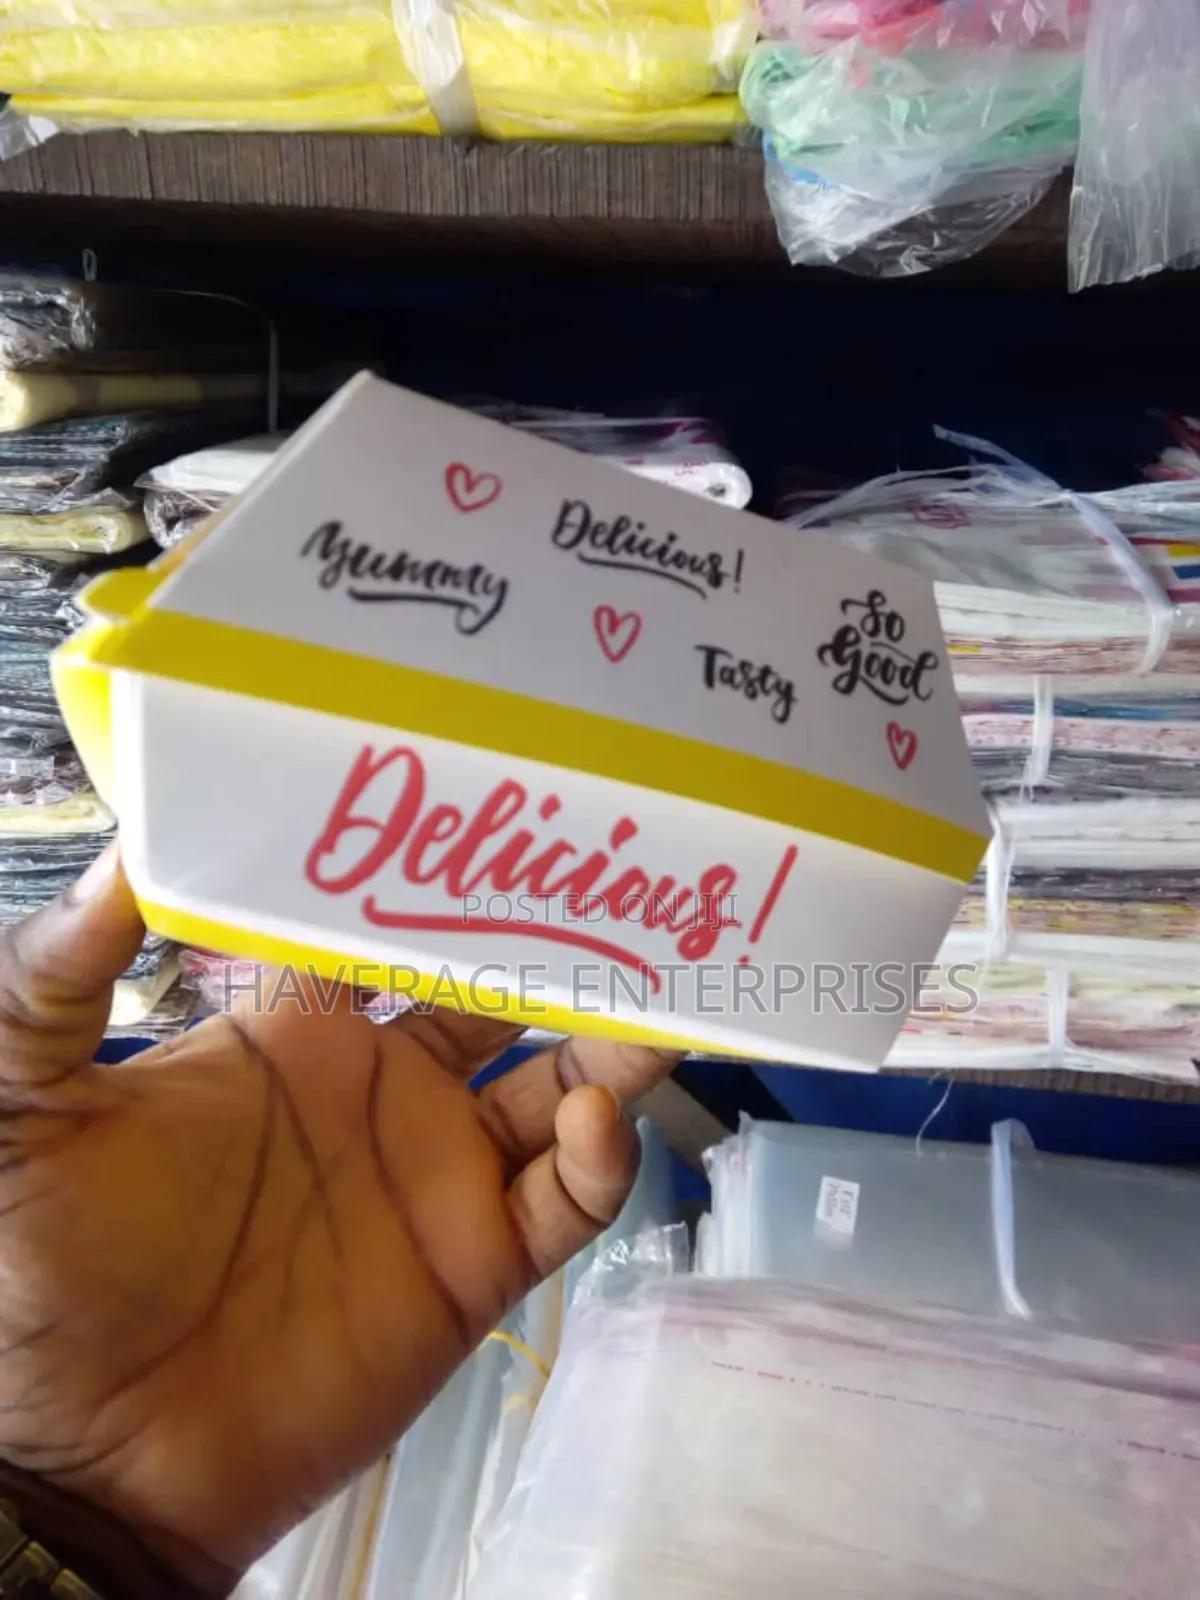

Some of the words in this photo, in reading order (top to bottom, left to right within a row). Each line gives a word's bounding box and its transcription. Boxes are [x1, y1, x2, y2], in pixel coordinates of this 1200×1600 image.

[301, 520, 509, 636] Yummy
[549, 498, 745, 600] Delicious!
[840, 588, 905, 642] So
[694, 644, 796, 724] Tasty
[816, 622, 938, 706] Good
[304, 743, 799, 968] Delicious!
